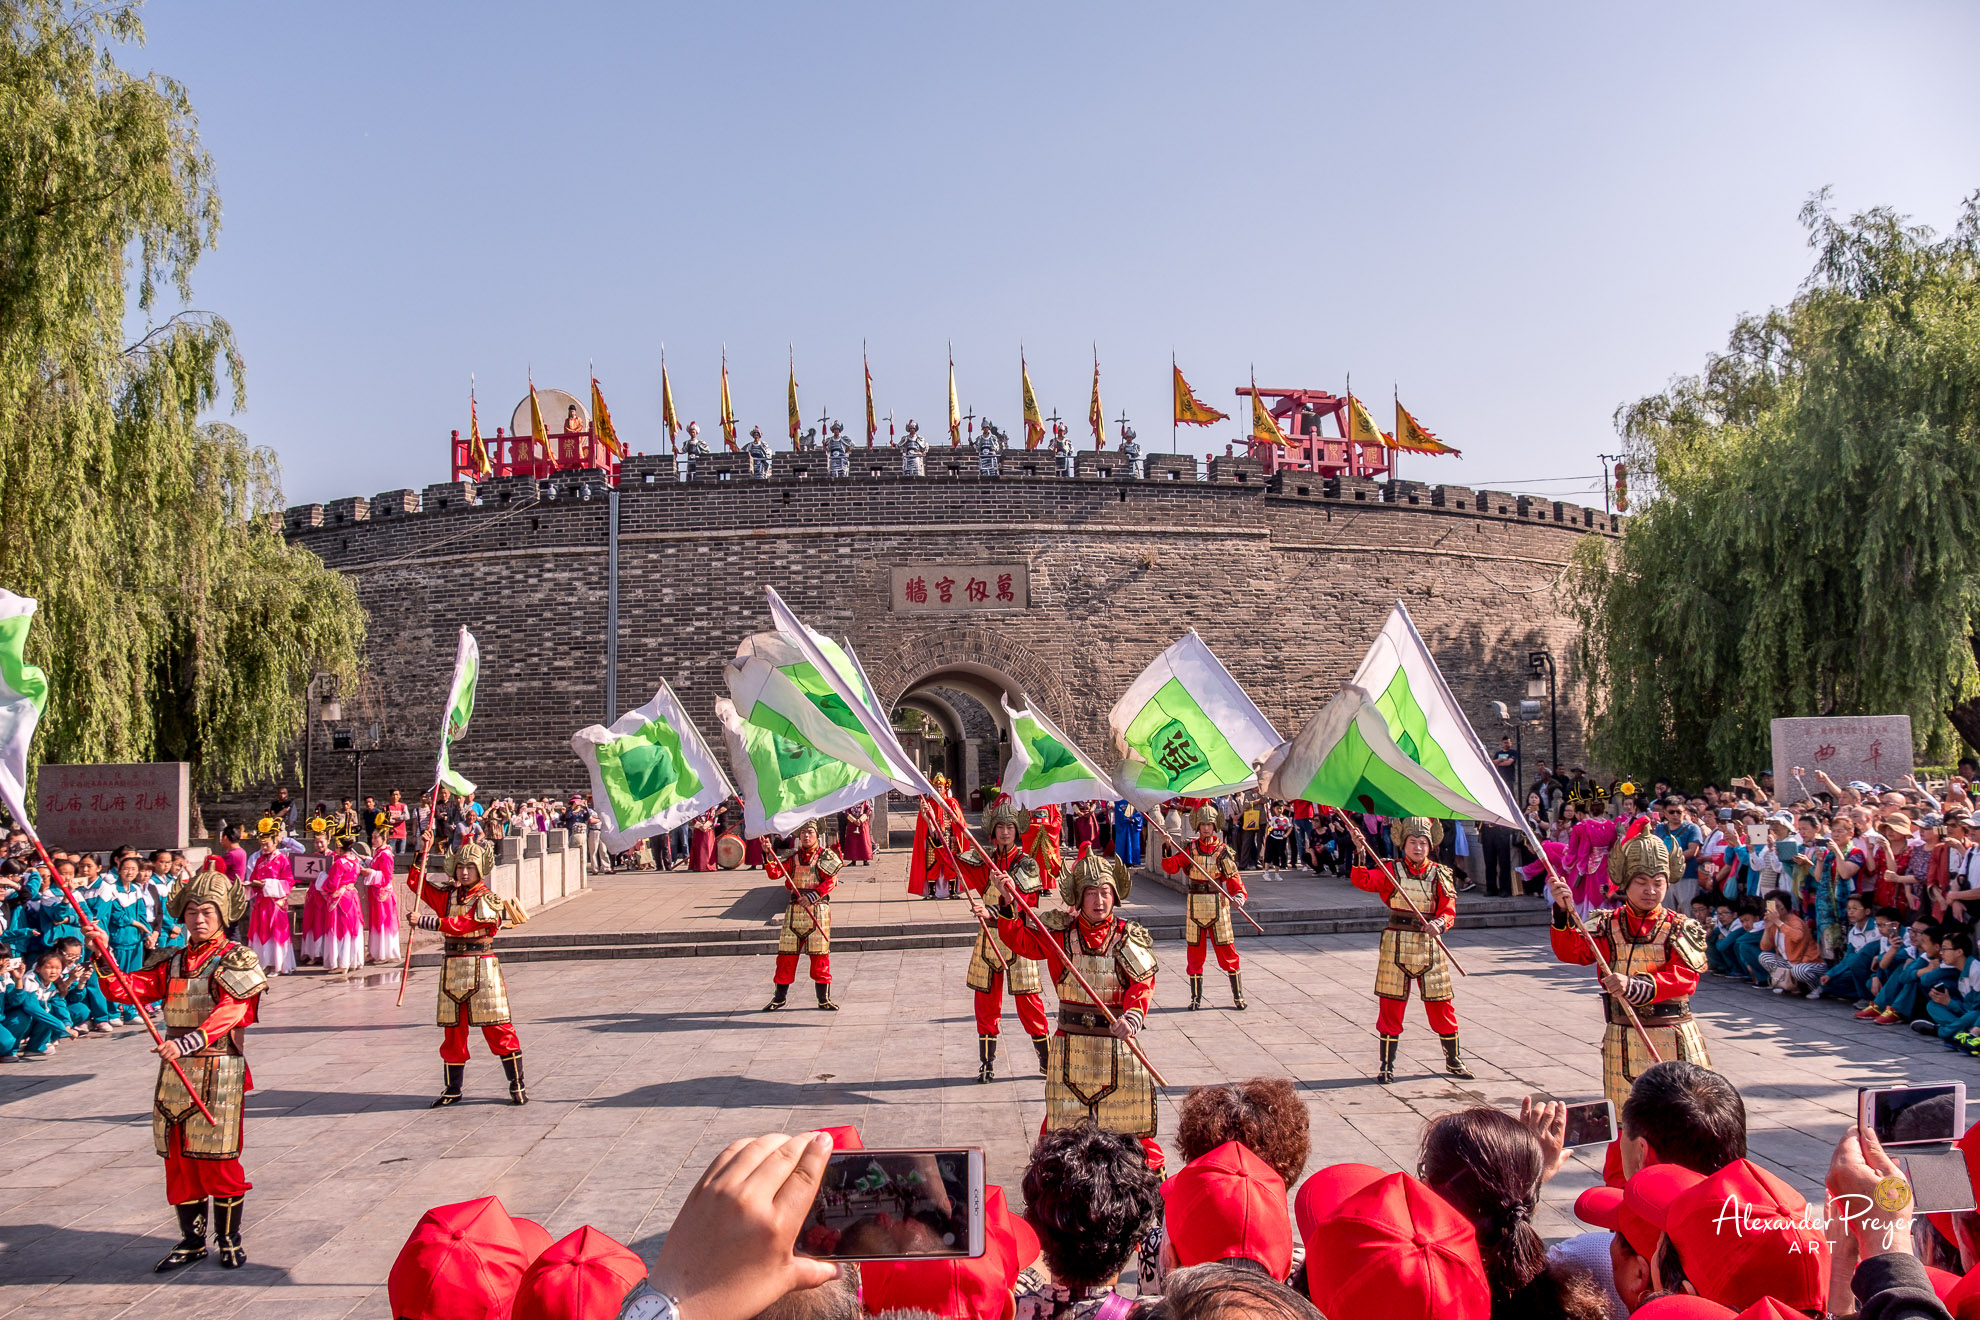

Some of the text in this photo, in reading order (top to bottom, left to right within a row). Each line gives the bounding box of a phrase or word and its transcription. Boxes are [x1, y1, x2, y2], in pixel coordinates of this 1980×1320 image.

[44, 791, 172, 812] 孔庙 孔府 孔林
